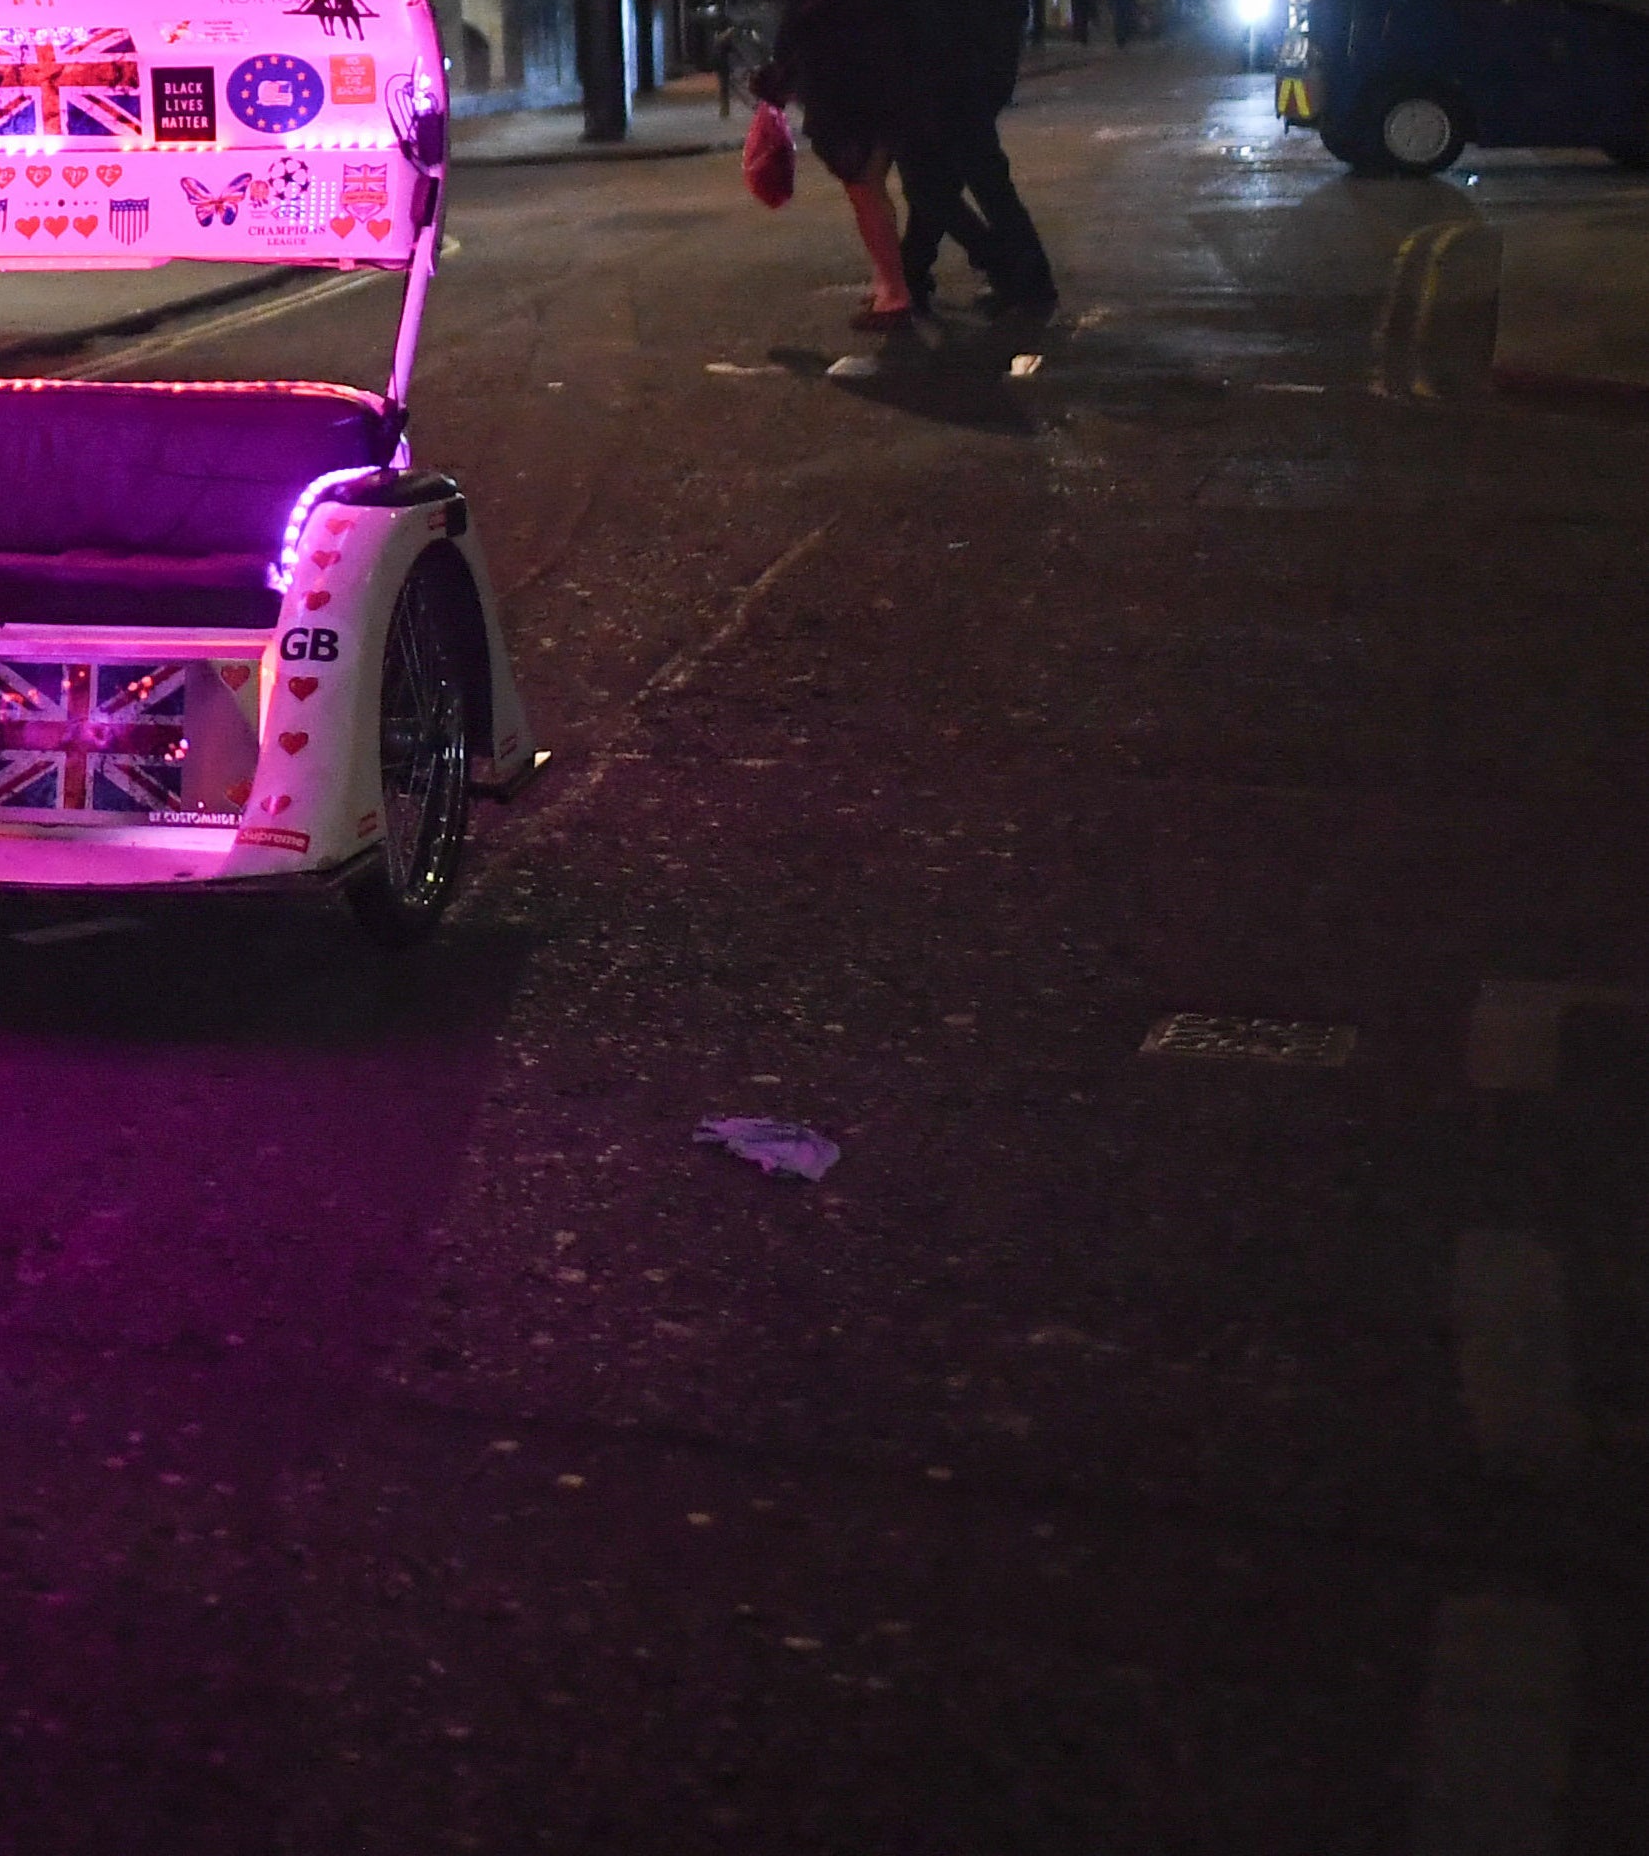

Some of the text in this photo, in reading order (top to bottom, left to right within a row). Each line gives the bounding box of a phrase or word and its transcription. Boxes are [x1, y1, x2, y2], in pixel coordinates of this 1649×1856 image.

[164, 82, 203, 95] BLACK
[165, 98, 204, 112] LIVES
[161, 115, 209, 129] MATTER
[266, 237, 306, 246] LEAGUE
[279, 627, 340, 663] GB
